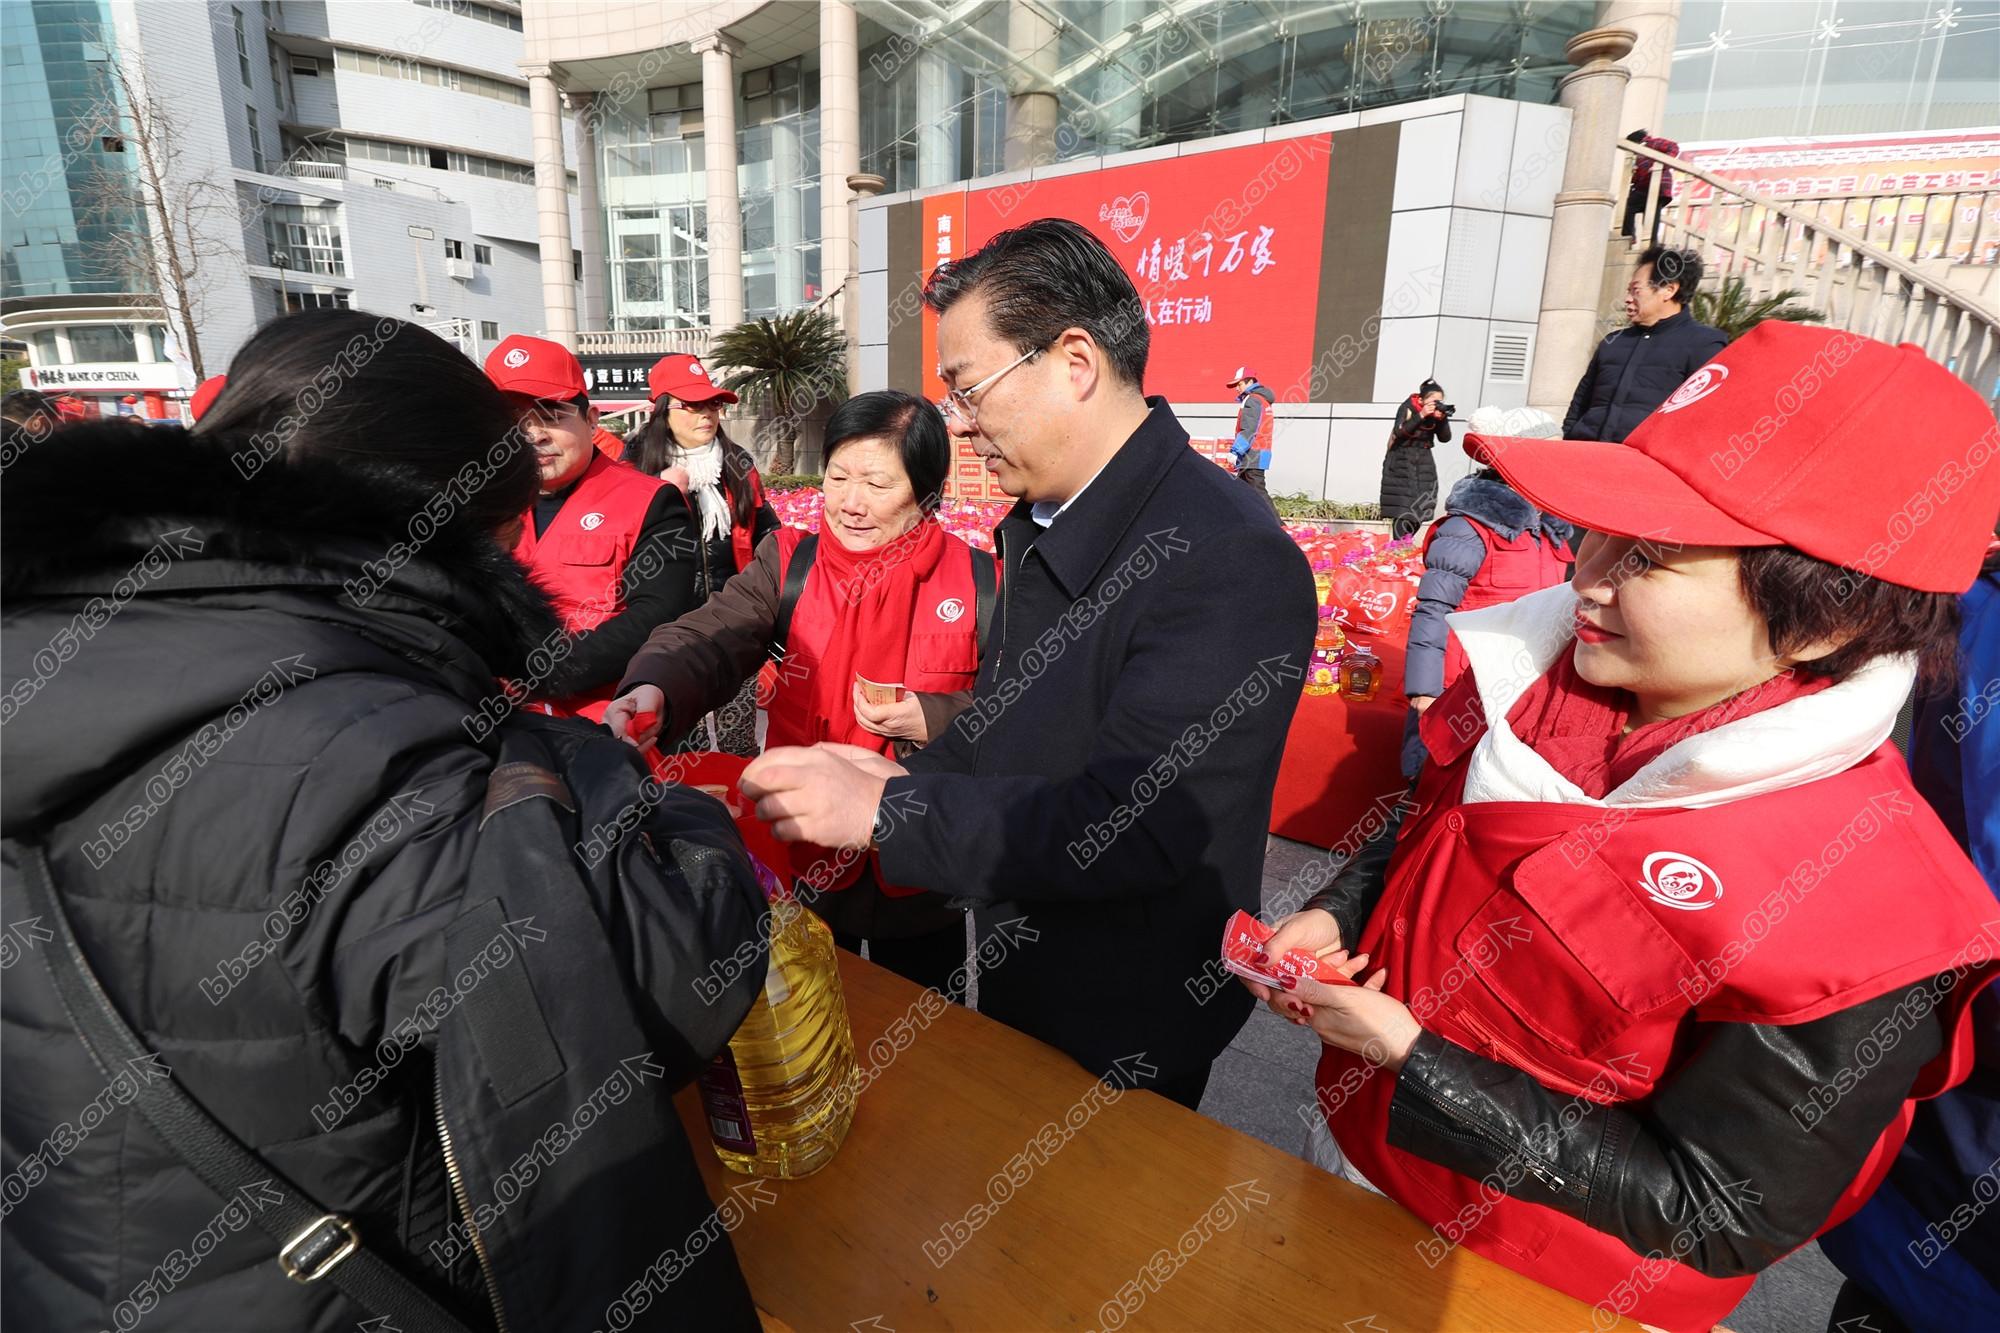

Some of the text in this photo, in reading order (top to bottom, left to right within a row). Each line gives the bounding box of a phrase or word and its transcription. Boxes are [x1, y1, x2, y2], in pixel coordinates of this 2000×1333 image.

[1136, 225, 1277, 283] 情暖千万家
[67, 371, 92, 382] BANK
[92, 371, 104, 382] OF
[105, 370, 140, 382] CHINA
